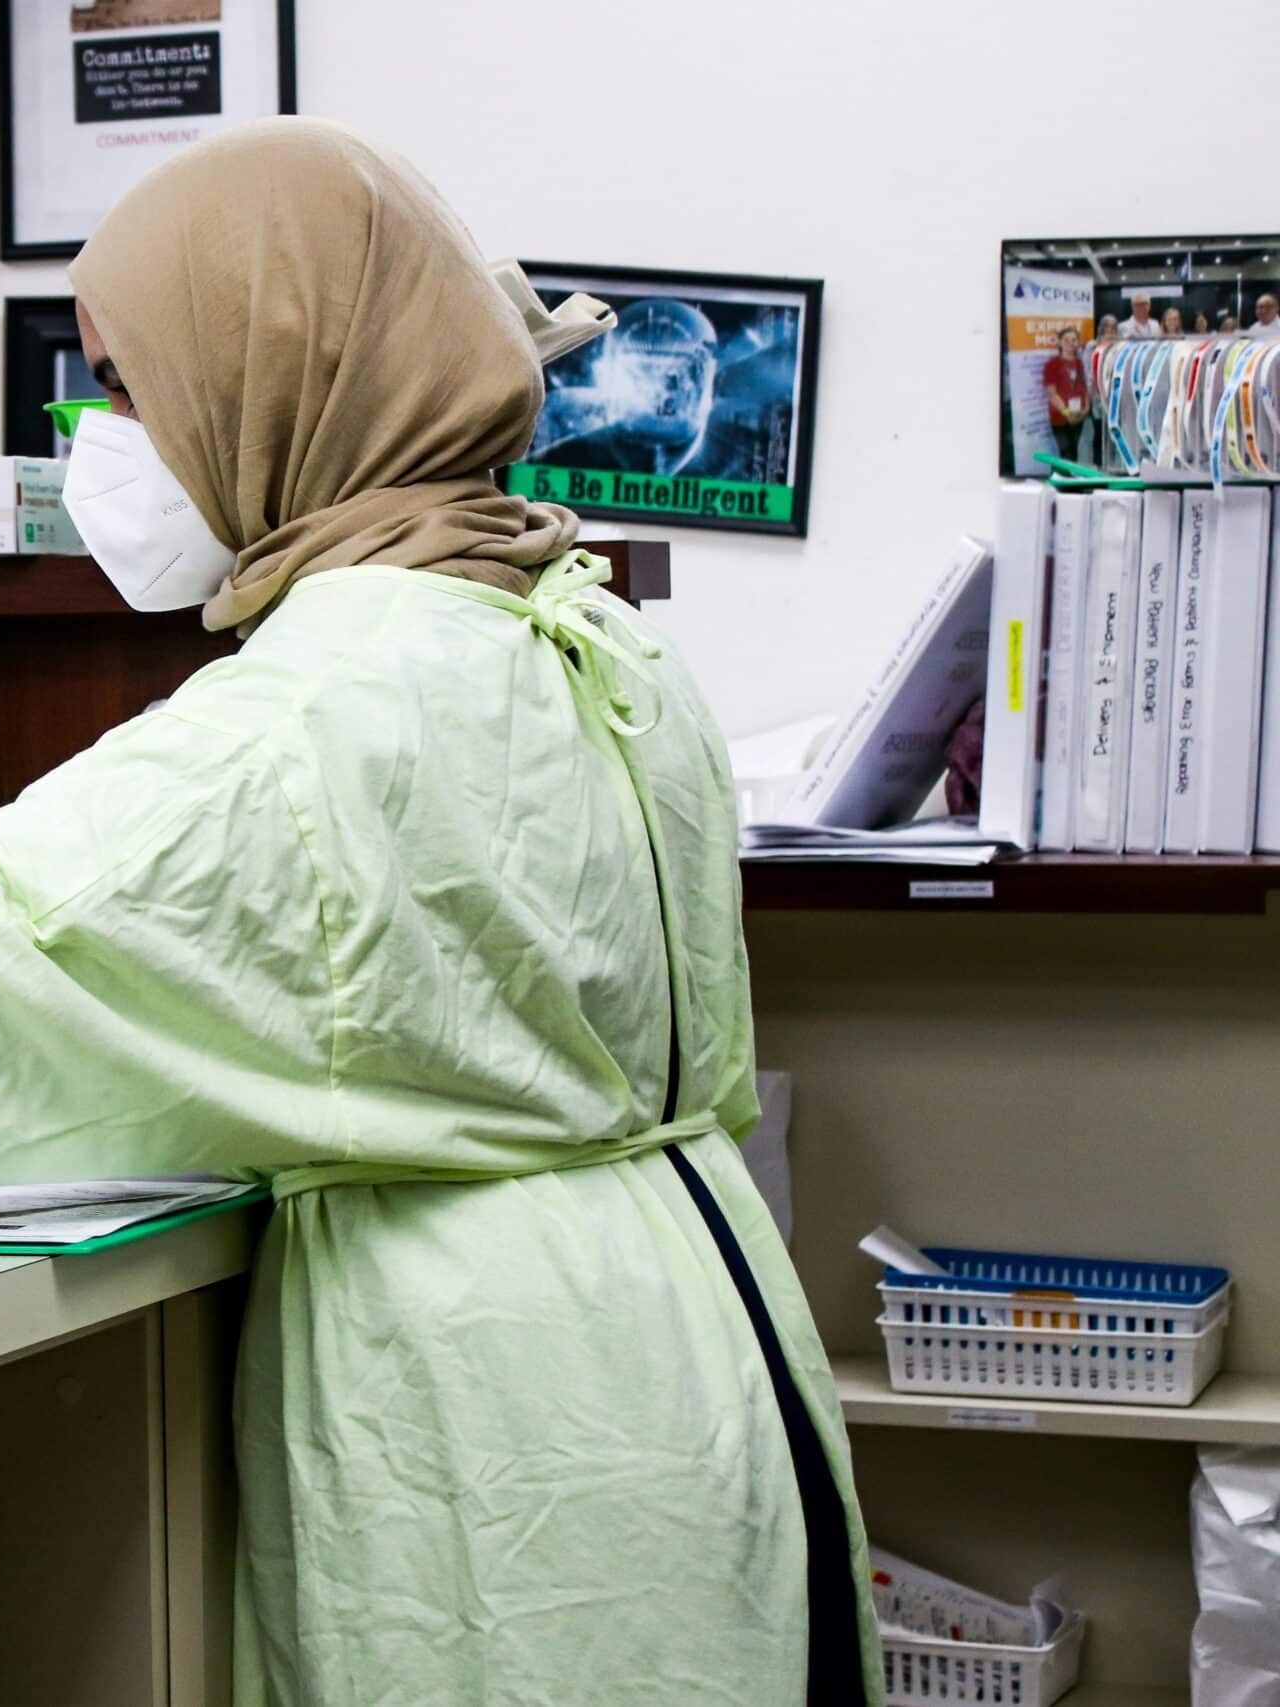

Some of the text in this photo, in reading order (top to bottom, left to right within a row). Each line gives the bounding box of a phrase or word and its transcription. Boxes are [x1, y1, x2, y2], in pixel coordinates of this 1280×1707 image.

[128, 69, 150, 81] you
[152, 67, 167, 78] do
[96, 127, 200, 149] COMMITMENT
[1042, 286, 1091, 303] CPESN
[532, 468, 770, 517] 5. Be Intelligent
[1093, 698, 1113, 757] Delivery
